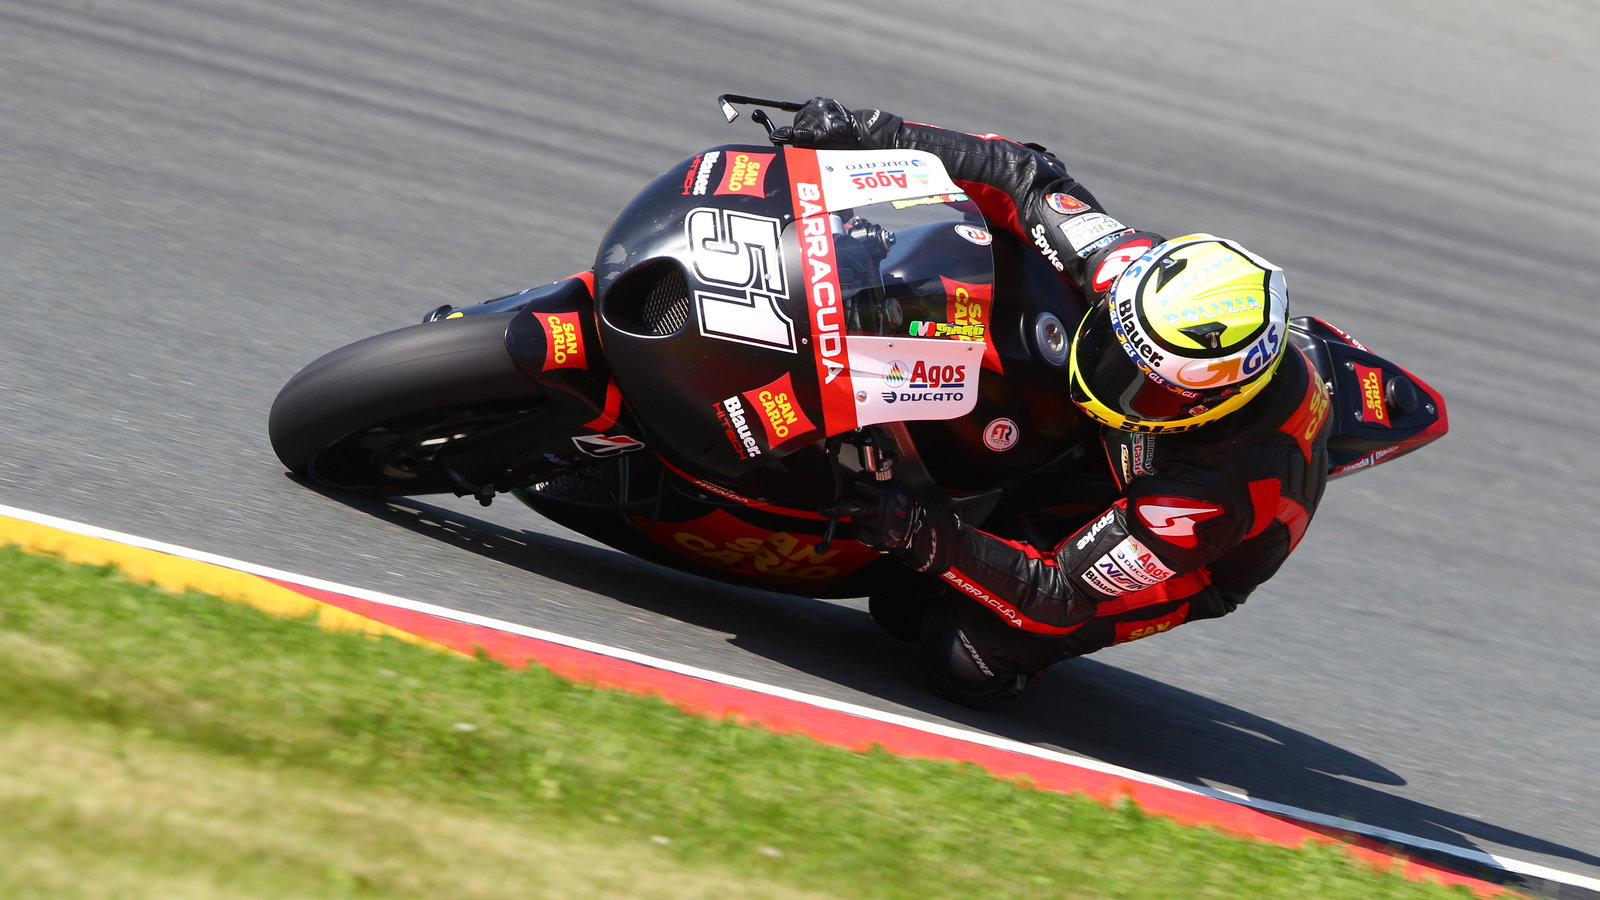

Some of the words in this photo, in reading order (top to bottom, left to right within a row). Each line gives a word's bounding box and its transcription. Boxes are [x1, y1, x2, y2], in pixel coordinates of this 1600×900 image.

[728, 154, 749, 191] CARLO
[743, 161, 761, 186] SAN
[852, 171, 908, 190] Agos
[1031, 223, 1064, 272] Spyke
[684, 207, 798, 354] 51
[796, 183, 845, 384] BARRACUDA
[1163, 296, 1262, 327] POLIZIA
[548, 315, 567, 364] CARLO
[562, 322, 578, 354] SAN
[1123, 343, 1137, 357] GLS
[1242, 324, 1279, 375] GLS
[909, 360, 966, 388] Agos
[1148, 372, 1165, 385] GLS
[774, 392, 798, 425] SAN
[900, 392, 964, 402] DUCATO
[1363, 378, 1375, 410] SAN
[1369, 371, 1383, 420] CARLO
[758, 390, 789, 438] CARLO
[1076, 509, 1115, 550] Spyke
[673, 532, 839, 579] CARLO
[725, 531, 842, 564] SAN
[1137, 552, 1169, 579] Agos
[943, 571, 1022, 627] BARRACUDA
